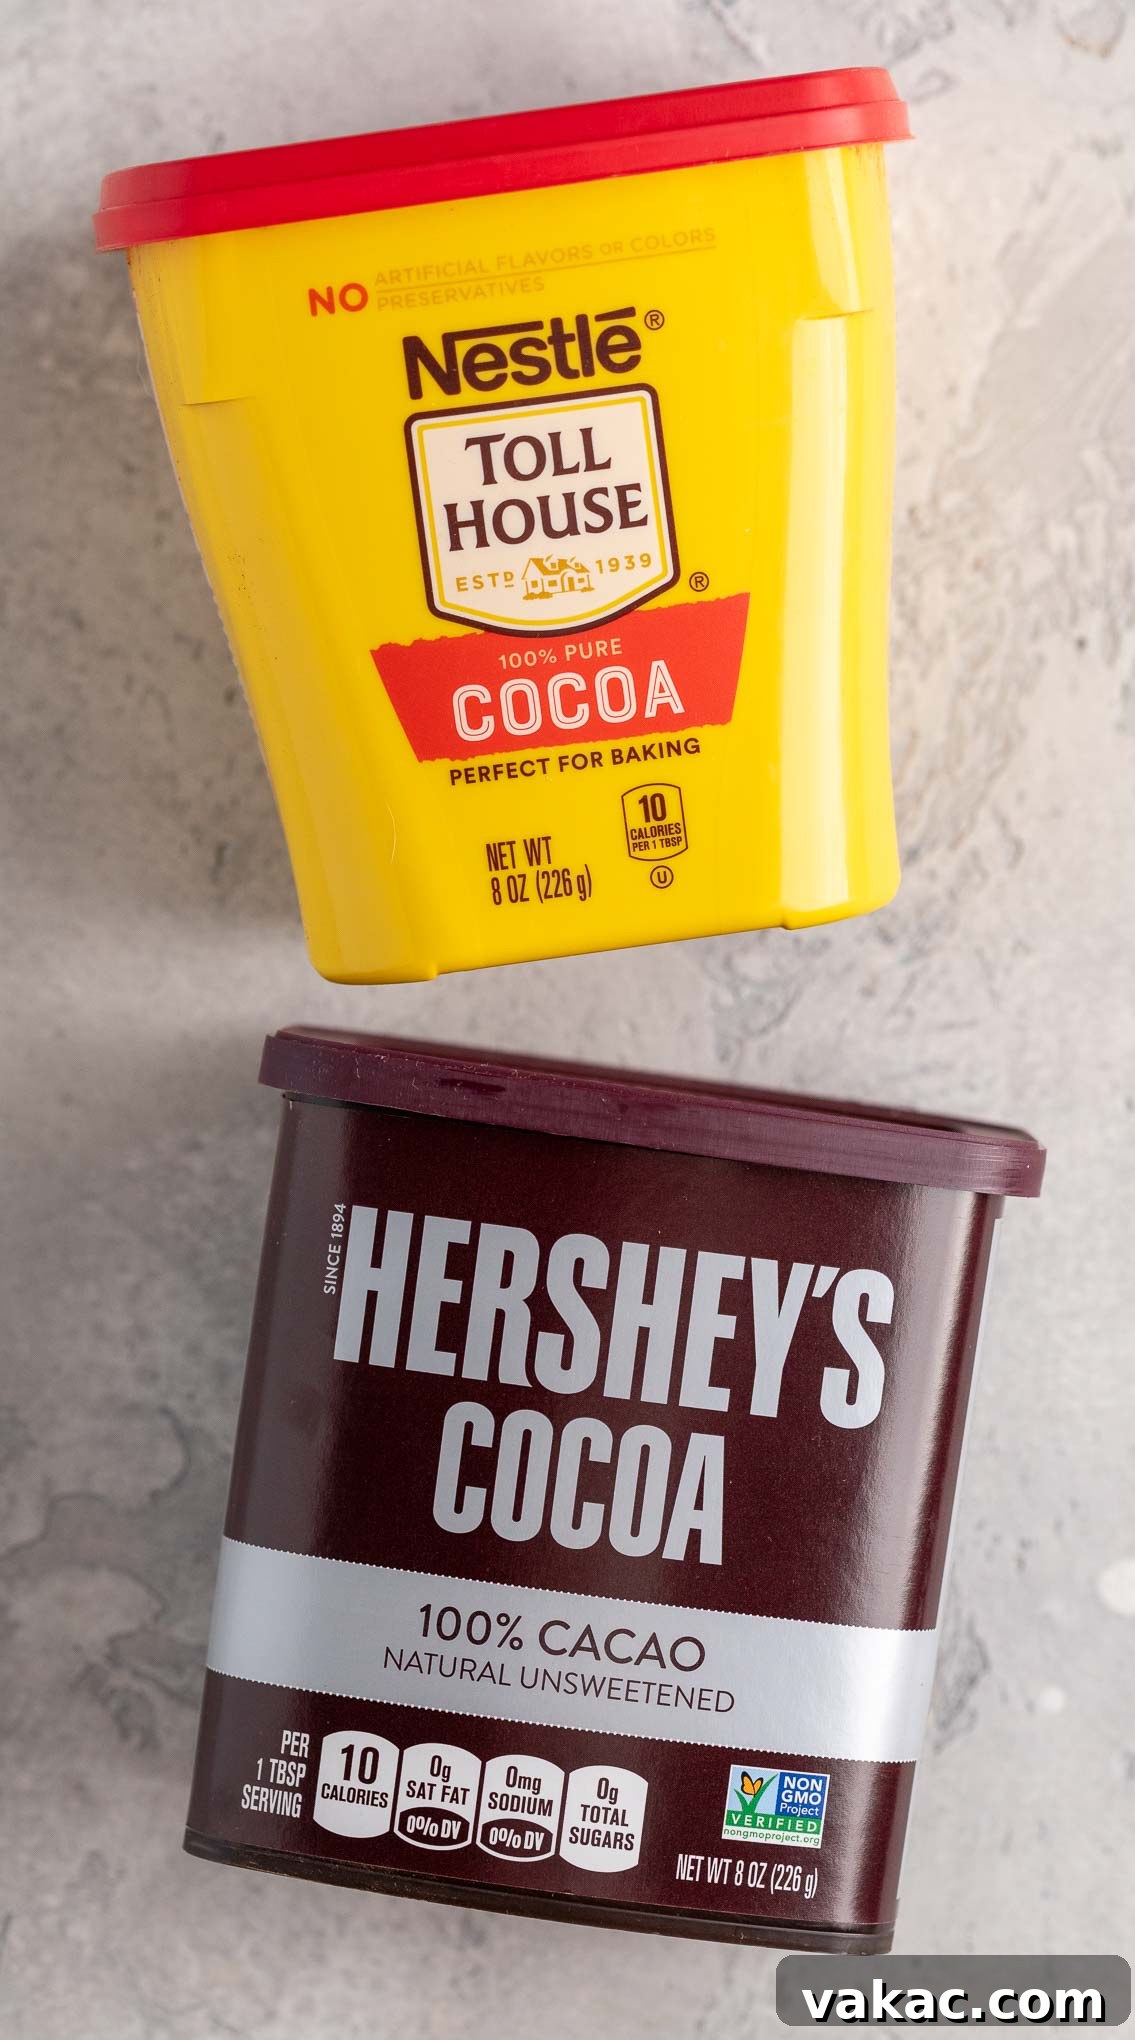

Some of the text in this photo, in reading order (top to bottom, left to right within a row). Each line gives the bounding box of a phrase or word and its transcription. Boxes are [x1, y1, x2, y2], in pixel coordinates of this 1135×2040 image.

[375, 259, 488, 287] ARTIFICIAL
[496, 244, 593, 271] FLAVORS
[630, 227, 716, 252] COLORS
[308, 282, 368, 316] NO
[376, 275, 545, 311] PRESERVATIVES
[464, 427, 612, 486] TOLL
[443, 482, 648, 552] HOUSE
[596, 553, 652, 573] 1939
[498, 638, 622, 670] 100% PURE
[452, 659, 685, 742] COCOA
[450, 738, 701, 785] PERFECT FOR BAKING
[638, 793, 666, 823] 10
[630, 822, 682, 840] CALORIES
[632, 837, 682, 852] PER 1 TBSP
[486, 836, 552, 871] NET WT
[491, 864, 592, 905] 8 OZ (226 g)
[323, 1203, 347, 1295] SINCE 1894
[433, 1401, 725, 1566] COCOA
[419, 1603, 705, 1672] 100% CACAO
[384, 1647, 735, 1713] NATURAL UNSWEETENED
[281, 1730, 310, 1758] PER
[256, 1758, 306, 1787] 1 TBSP
[340, 1744, 380, 1785] 10
[429, 1755, 451, 1782] 0g
[406, 1780, 470, 1806] SAT FAT
[505, 1766, 542, 1796] 0mg
[596, 1777, 619, 1804] 0g
[783, 1775, 823, 1791] NON
[241, 1784, 303, 1818] SERVING
[321, 1783, 389, 1809] CALORIES
[488, 1792, 554, 1817] SODIUM
[779, 1802, 820, 1817] Project
[781, 1789, 822, 1806] GMO
[407, 1815, 461, 1840] 0% DV
[581, 1804, 629, 1827] TOTAL
[730, 1813, 819, 1832] VERIFIED
[489, 1827, 545, 1851] 0% DV
[568, 1827, 634, 1851] SUGARS
[723, 1827, 821, 1846] nongmoproject.org
[676, 1853, 819, 1899] NET WT 8 OZ (226 g)
